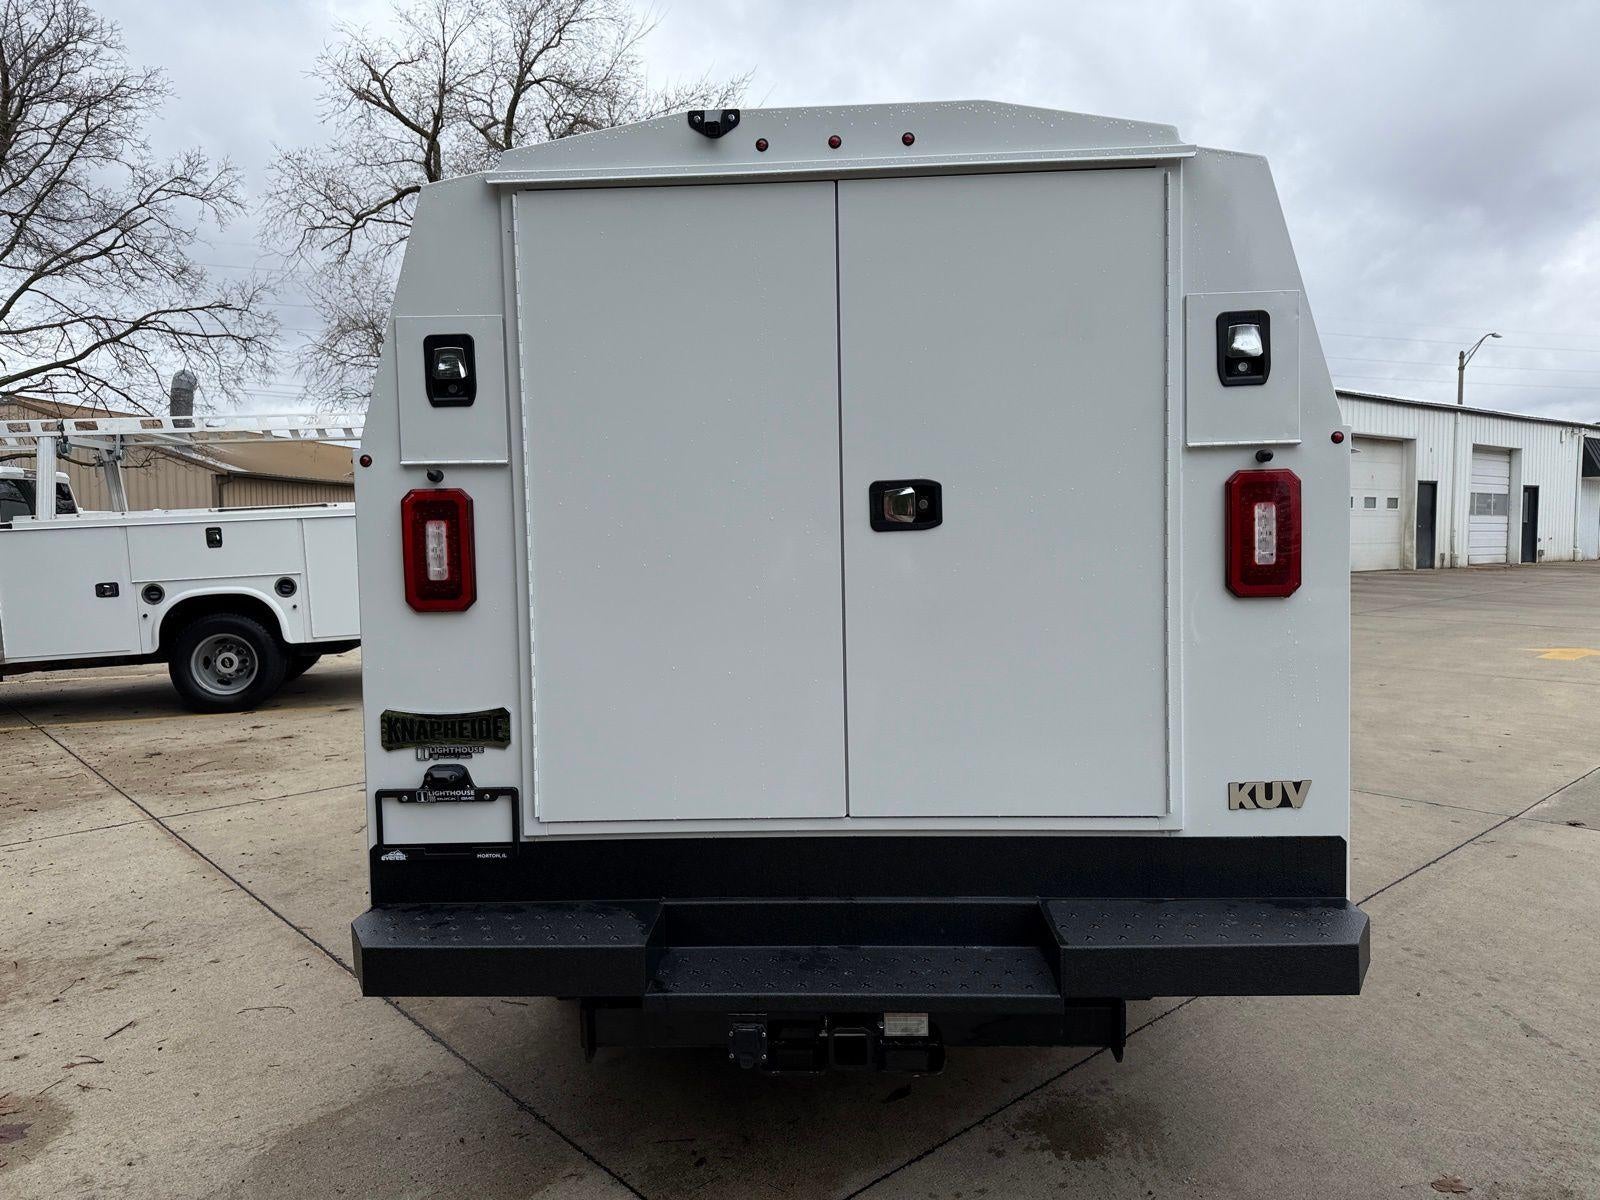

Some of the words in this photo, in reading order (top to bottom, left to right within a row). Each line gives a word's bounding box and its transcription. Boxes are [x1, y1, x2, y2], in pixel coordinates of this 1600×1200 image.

[387, 714, 505, 742] KNAPHEIDE
[430, 746, 485, 754] LIGHTHOUSE
[1228, 780, 1312, 810] KUV
